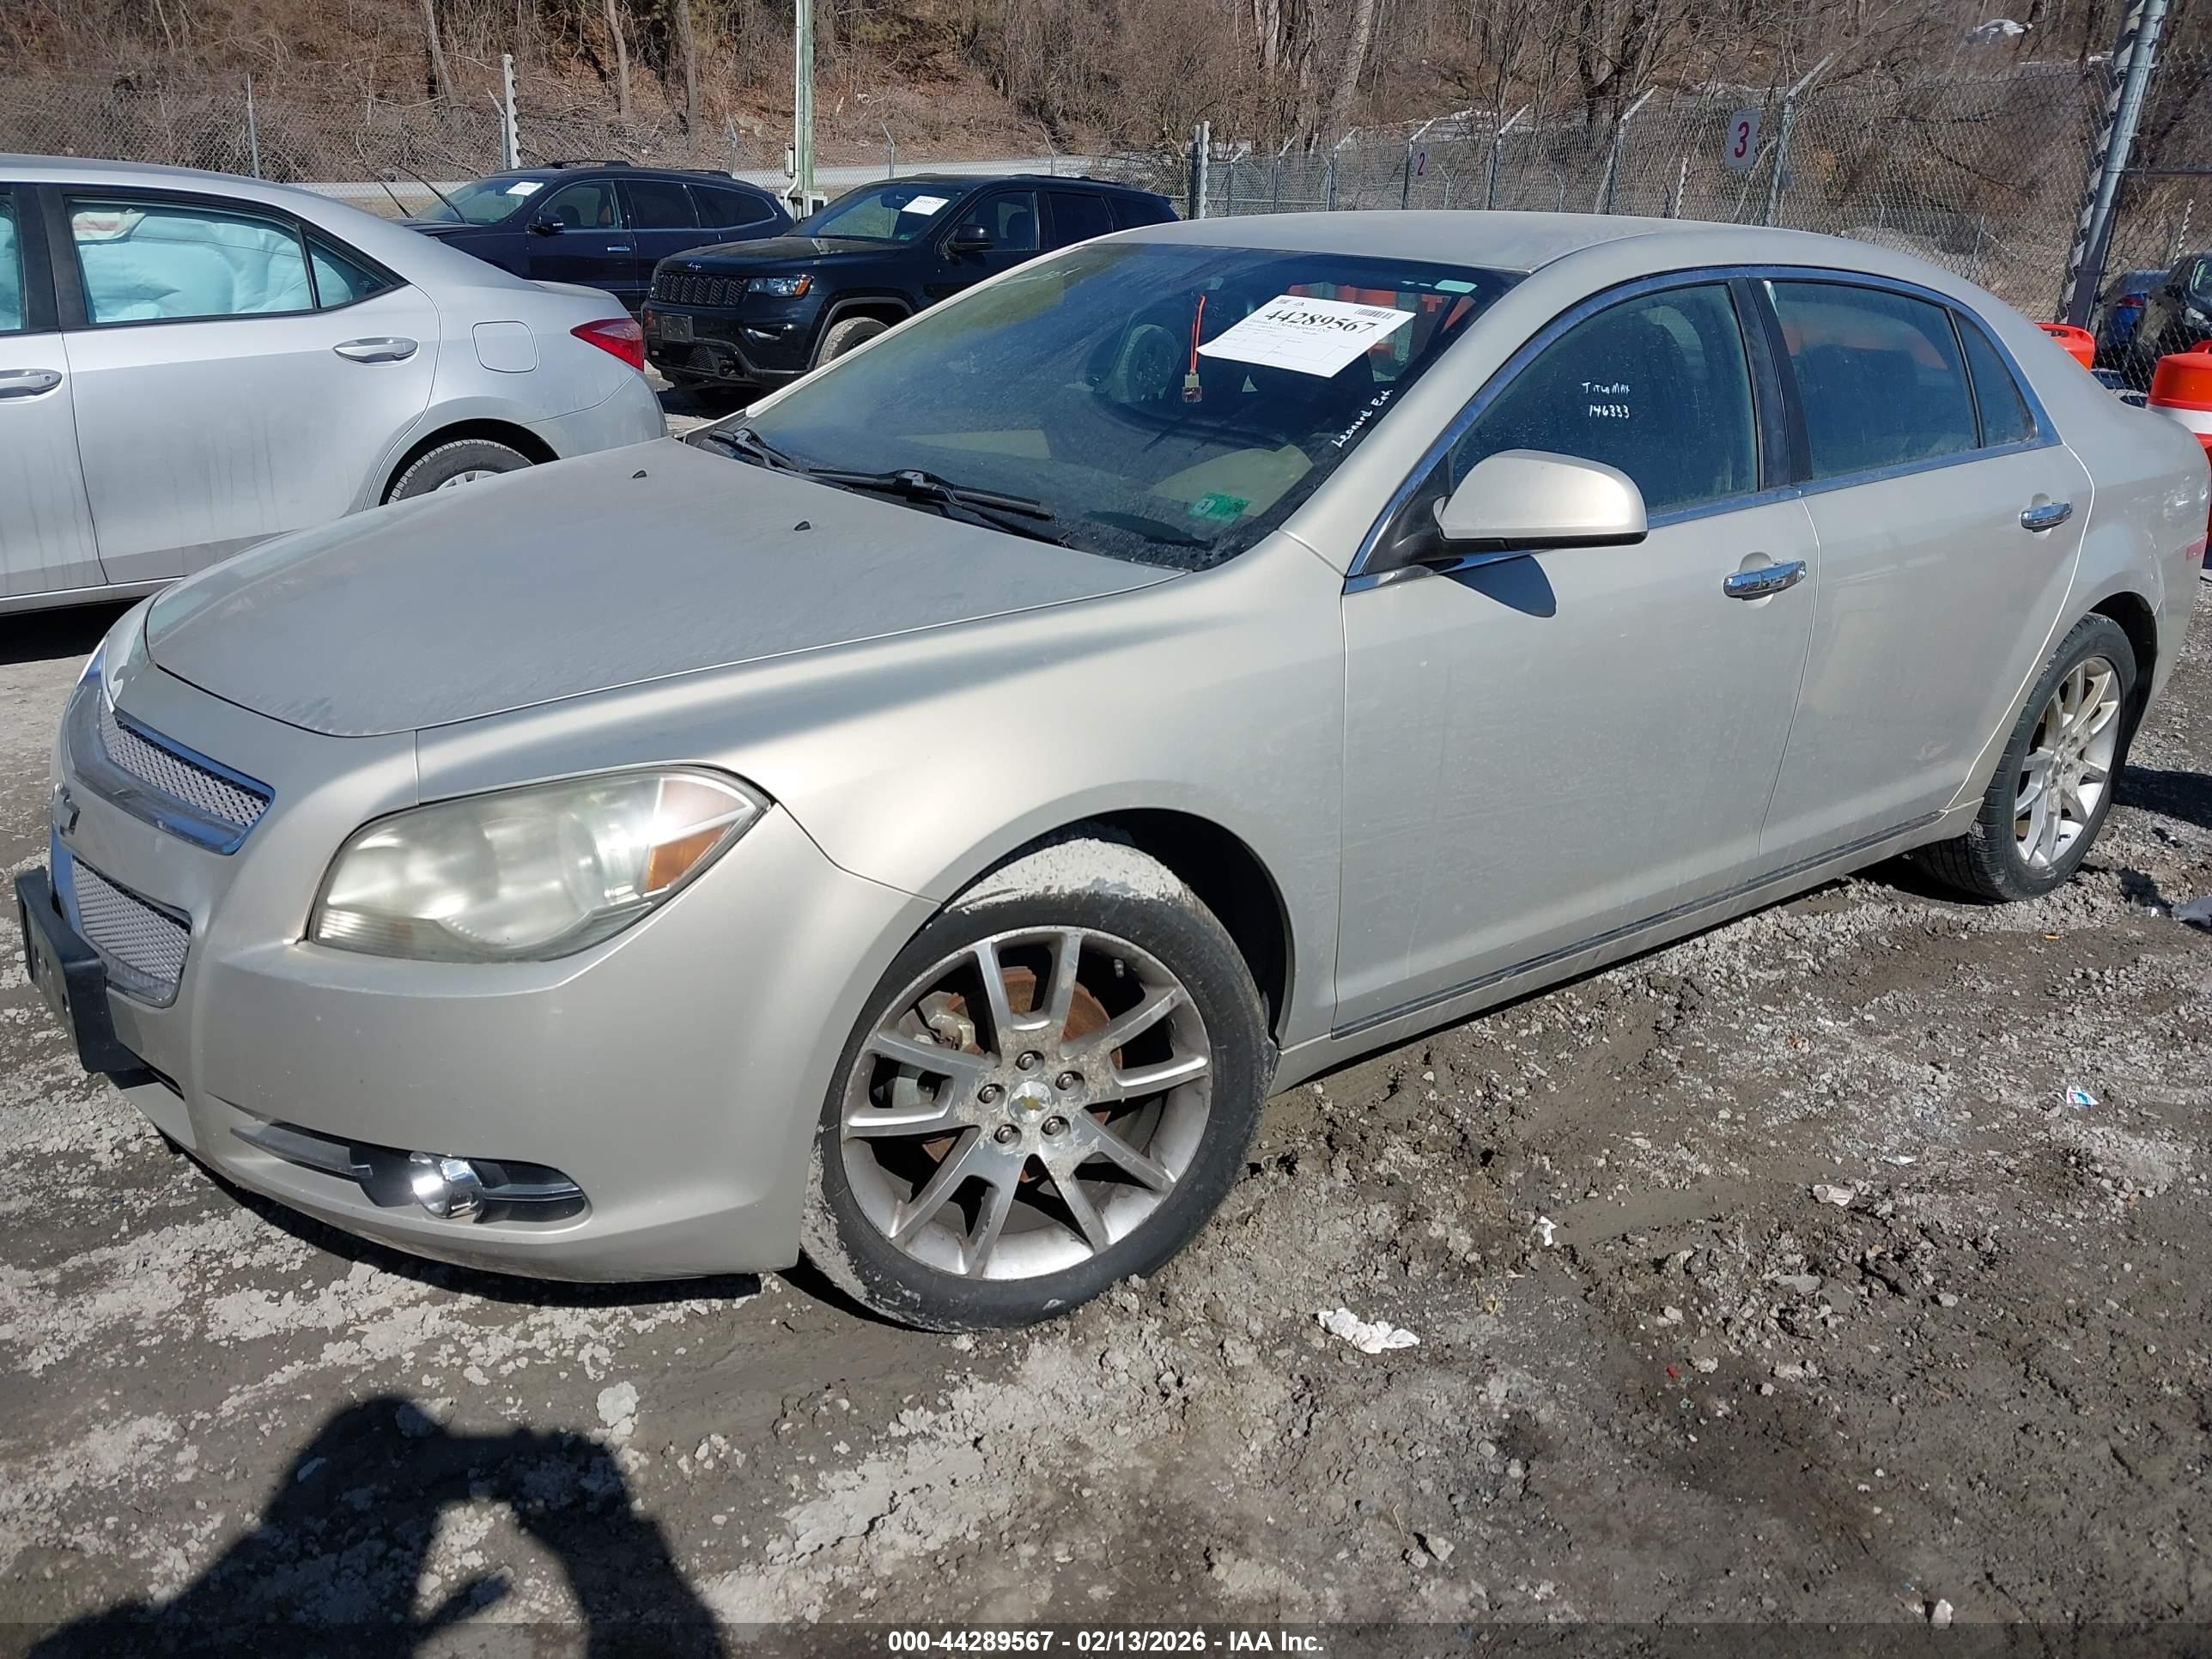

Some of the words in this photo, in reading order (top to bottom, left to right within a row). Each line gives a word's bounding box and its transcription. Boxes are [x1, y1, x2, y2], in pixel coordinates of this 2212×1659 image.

[1735, 121, 1749, 158] 3
[1417, 152, 1425, 176] 2
[1265, 309, 1380, 334] 44289567
[1589, 404, 1629, 419] 146333
